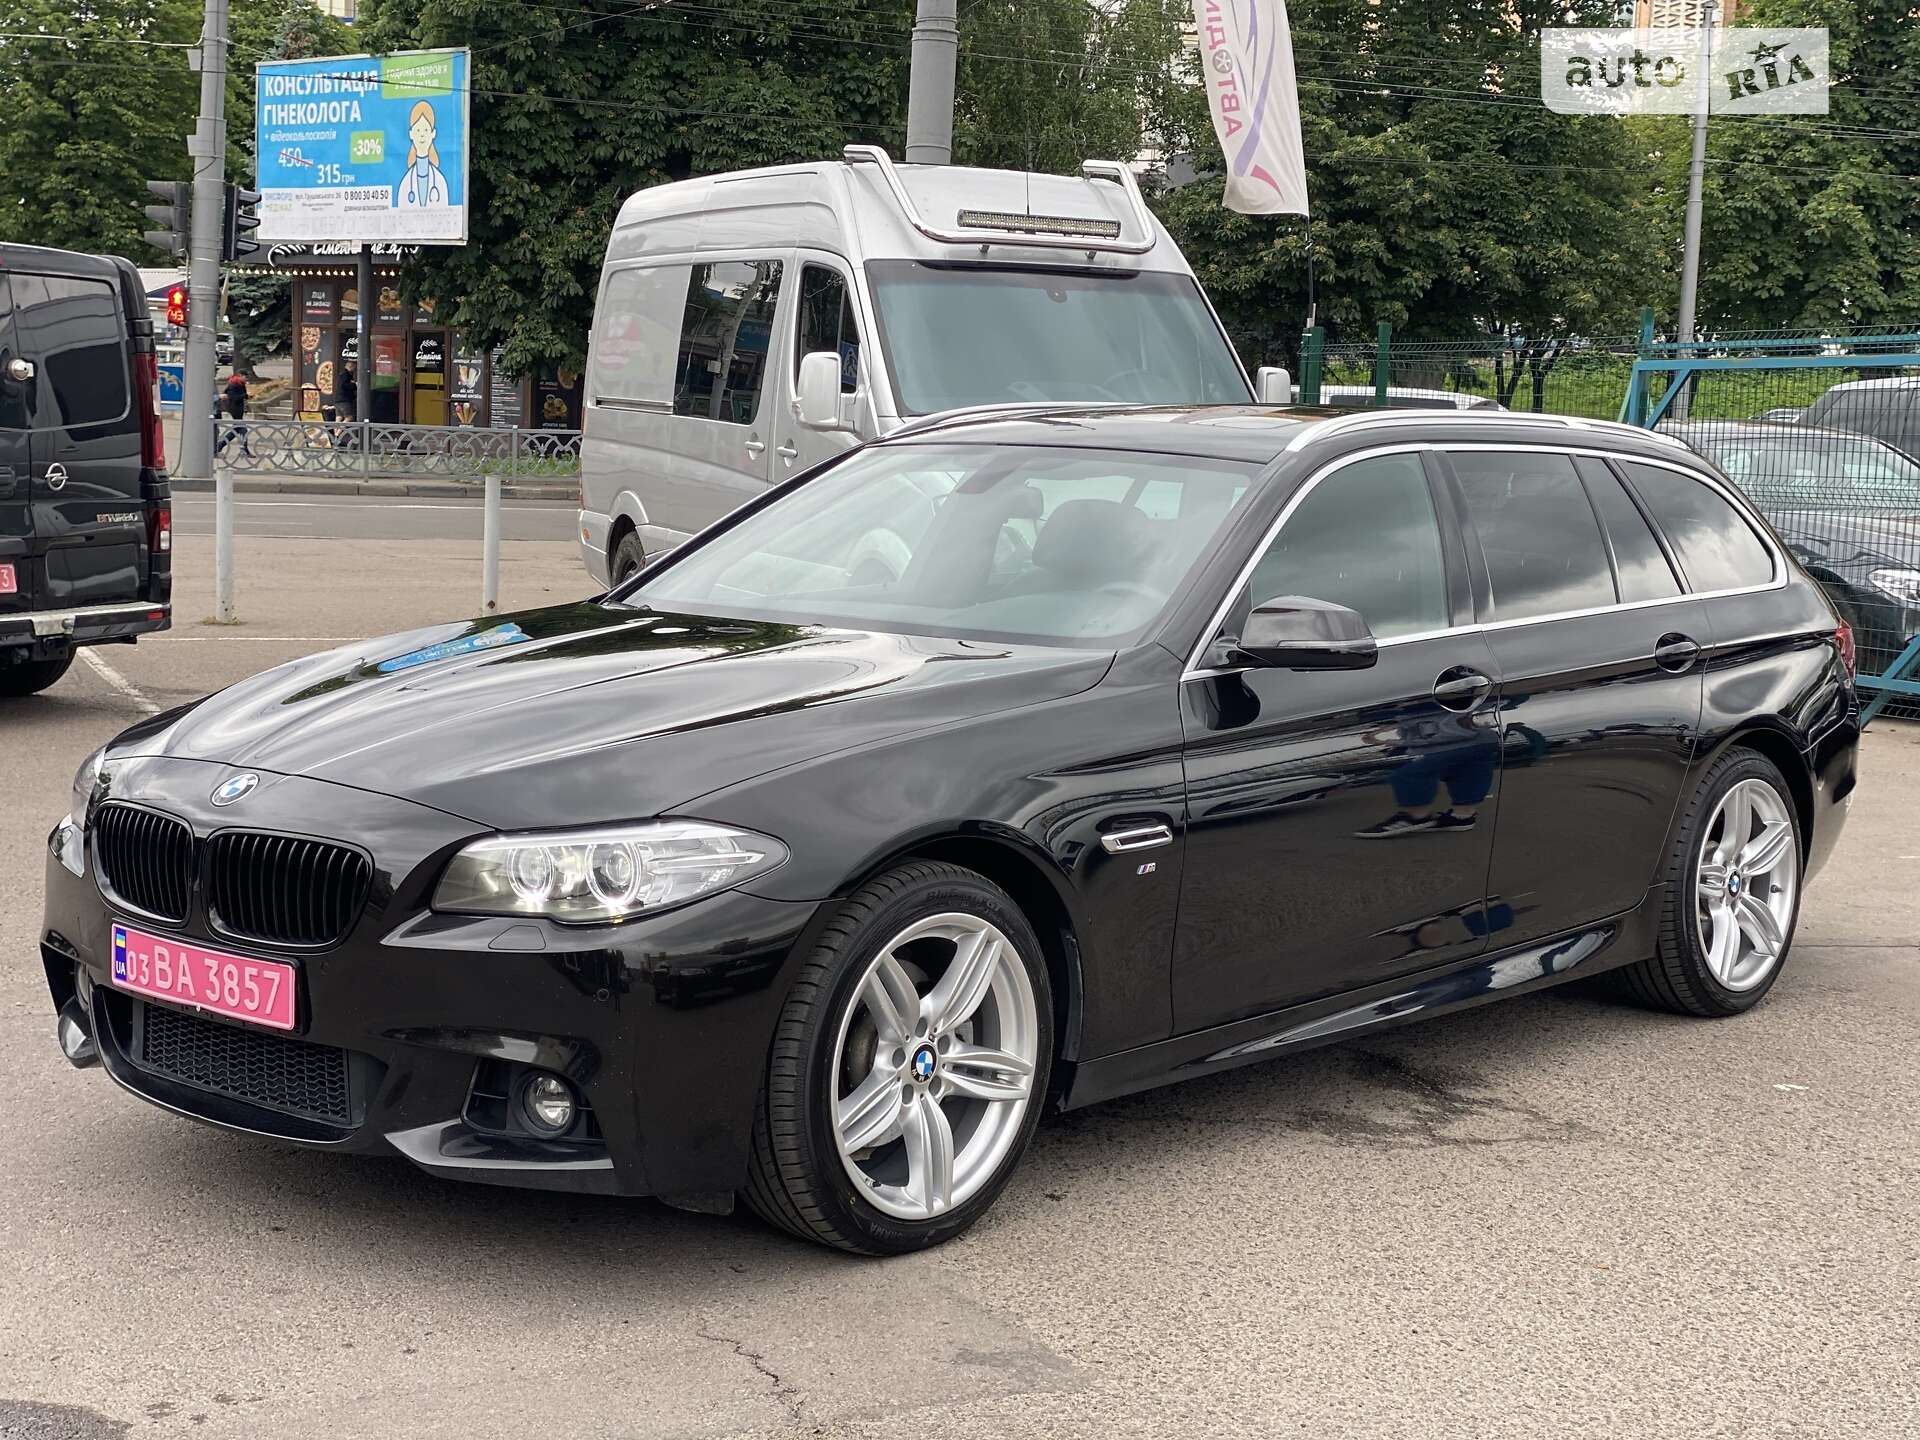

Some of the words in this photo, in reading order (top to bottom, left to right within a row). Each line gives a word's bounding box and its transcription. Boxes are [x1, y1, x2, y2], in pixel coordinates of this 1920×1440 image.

[265, 70, 379, 98] КОНСУЛЬТАЦІЯ
[264, 100, 362, 126] ГІНЕКОЛОГА
[353, 139, 381, 156] -30%
[116, 960, 126, 975] UA
[205, 960, 281, 1015] 3857
